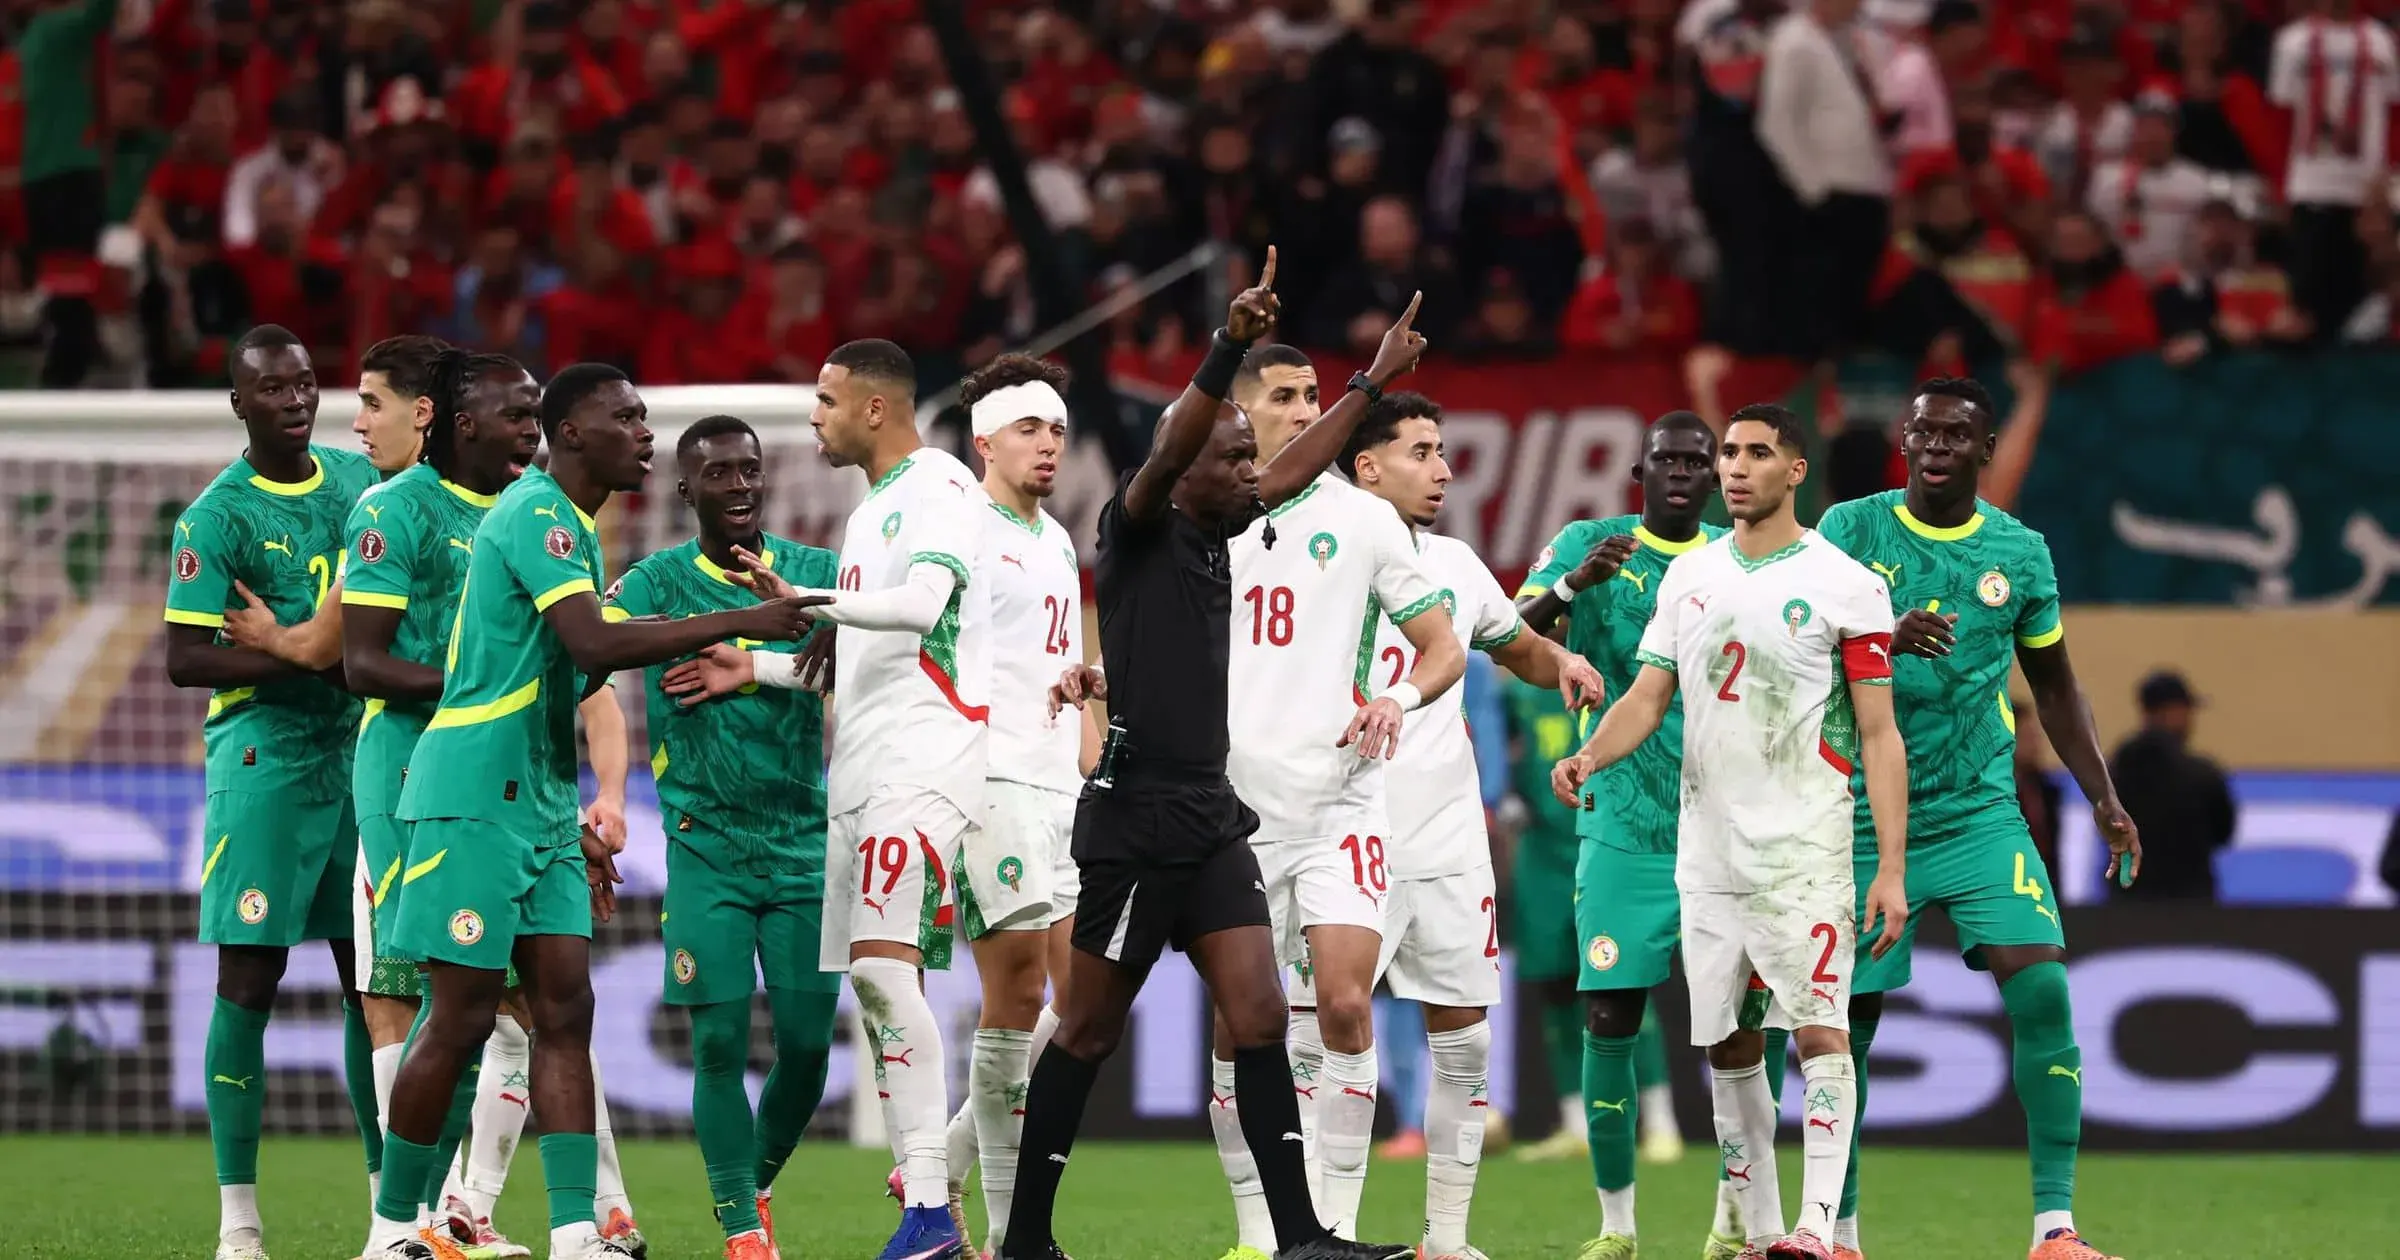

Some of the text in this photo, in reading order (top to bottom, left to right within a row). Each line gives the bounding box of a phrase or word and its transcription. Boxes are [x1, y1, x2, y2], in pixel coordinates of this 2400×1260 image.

[1045, 595, 1070, 657] 24
[1244, 585, 1294, 647] 18
[1717, 641, 1746, 702] 2
[858, 836, 908, 895] 19
[1339, 834, 1387, 892] 18
[2013, 852, 2043, 901] 4
[1811, 923, 1838, 983] 2
